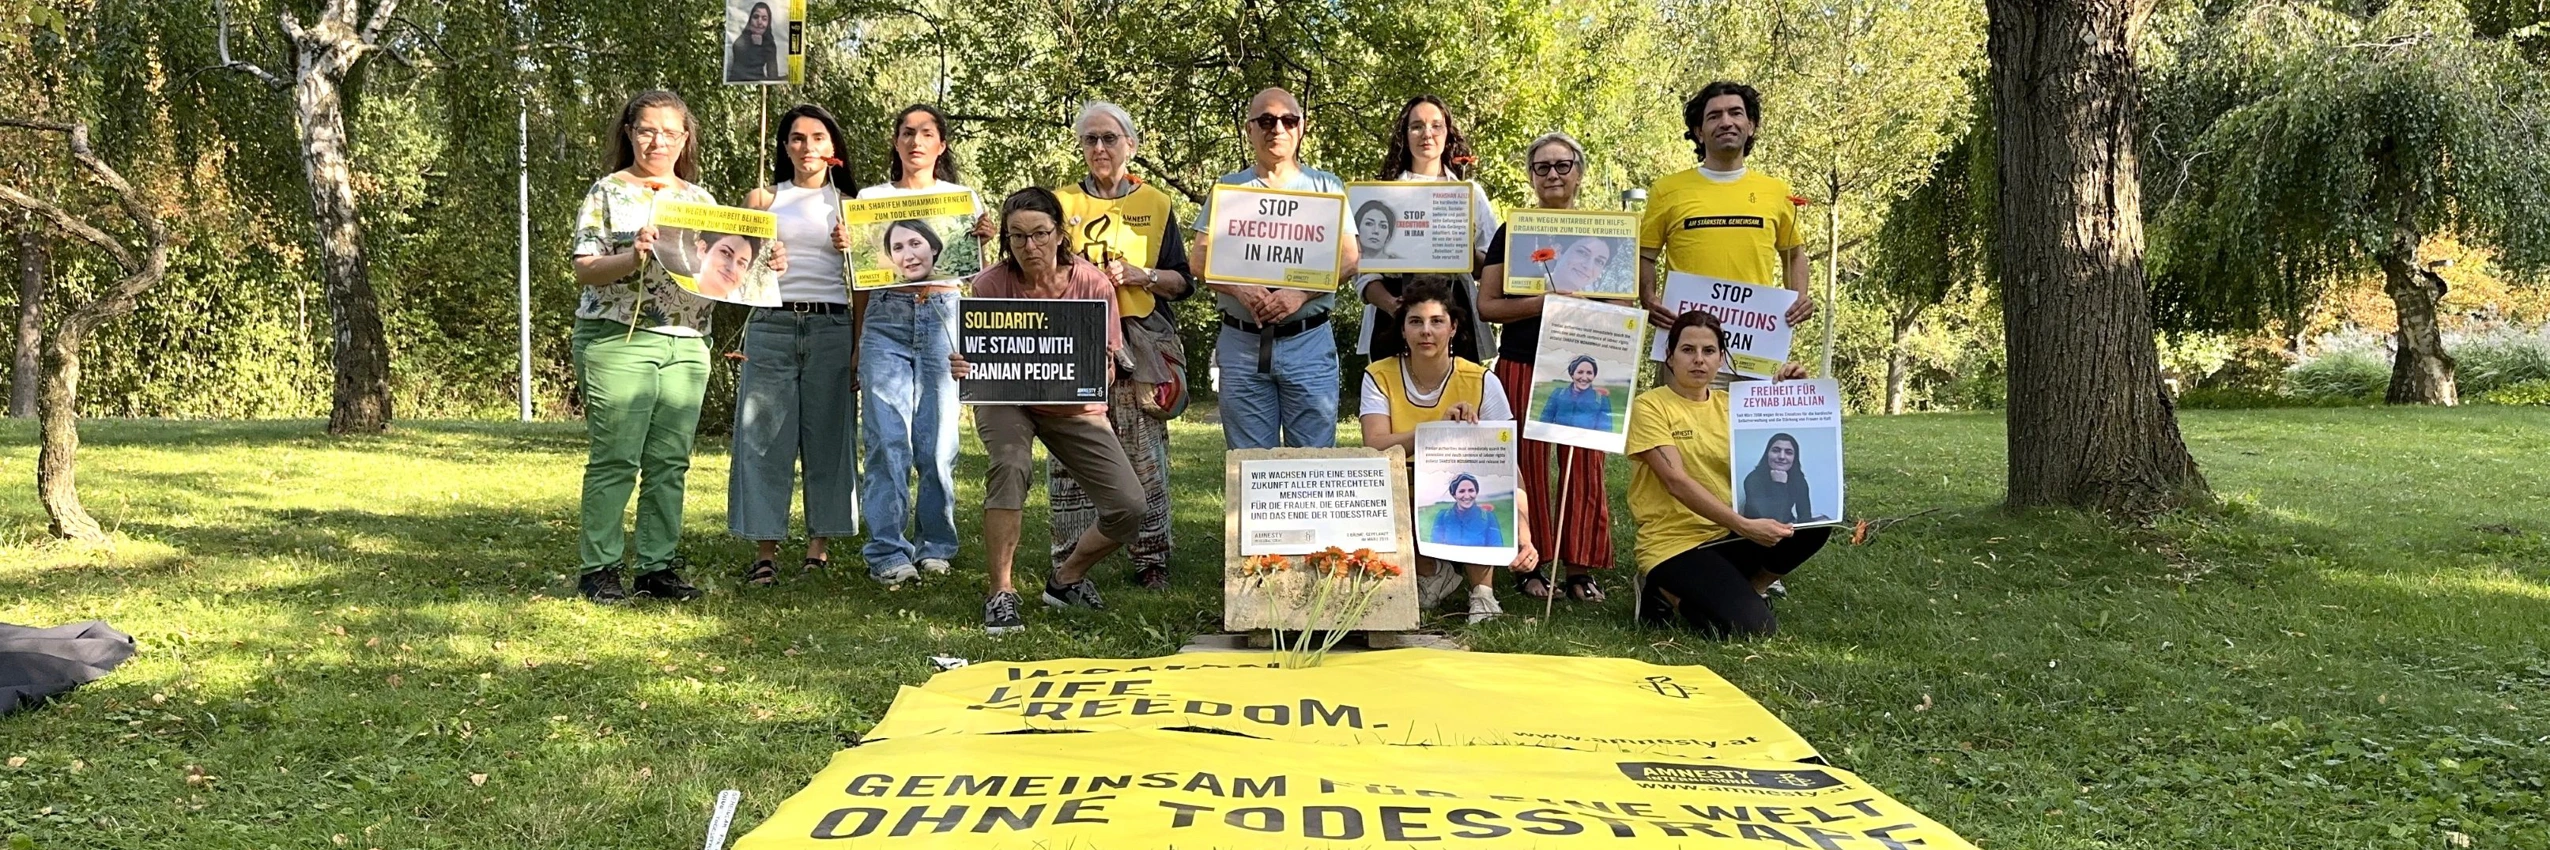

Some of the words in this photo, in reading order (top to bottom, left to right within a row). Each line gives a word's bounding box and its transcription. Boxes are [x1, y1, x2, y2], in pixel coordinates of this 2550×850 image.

[868, 200, 901, 210] SHARIFEH
[902, 197, 942, 208] MOHAMMADI
[943, 195, 969, 205] ERNEUT
[1258, 198, 1299, 217] STOP
[685, 207, 707, 217] WEGEN
[708, 210, 741, 221] MITARBEIT
[741, 213, 752, 222] BEI
[874, 212, 889, 220] ZUM
[891, 210, 907, 219] TODE
[909, 207, 946, 217] VERURTEILT
[1122, 214, 1151, 223] AMNESTY
[1404, 211, 1426, 220] STOP
[659, 214, 705, 227] ORGANISATION
[706, 219, 720, 229] ZUM
[721, 221, 737, 232] TODE
[1228, 219, 1325, 242] EXECUTIONS
[1593, 227, 1631, 235] VERURTEILT!
[1245, 243, 1261, 261] IN
[1267, 245, 1304, 264] IRAN
[1711, 283, 1753, 304] STOP
[965, 311, 1049, 330] SOLIDARITY:
[965, 336, 986, 354] WE
[990, 336, 1035, 354] STAND
[1038, 336, 1074, 354] WITH
[1025, 363, 1075, 381] PEOPLE
[1751, 385, 1794, 396] FREIHEIT
[1797, 383, 1815, 395] FÜR
[1743, 397, 1779, 408] ZEYNAB
[1782, 395, 1825, 407] JALALIAN
[1251, 472, 1266, 480] WIR
[1269, 471, 1307, 479] WACHSEN
[1309, 469, 1324, 478] FÜR
[1327, 470, 1344, 478] EINE
[1347, 469, 1384, 478] BESSERE
[1251, 481, 1288, 490] ZUKUNFT
[1291, 480, 1317, 489] ALLER
[1320, 479, 1385, 488] ENTRECHTETEN
[1280, 490, 1323, 499] MENSCHEN
[1325, 490, 1334, 498] IM
[1251, 500, 1267, 510] FÜR
[1269, 502, 1281, 510] DIE
[1320, 501, 1333, 509] DIE
[1334, 499, 1387, 508] GEFANGENEN
[1251, 512, 1267, 520] UND
[1269, 511, 1286, 520] DAS
[1288, 511, 1309, 519] ENDE
[1311, 511, 1327, 519] DER
[1330, 509, 1388, 518] TODESSTRAFE
[1513, 732, 1761, 748] www.amnesty.at
[1643, 767, 1749, 780] AMNESTY
[1647, 775, 1759, 786] INTERNATIONAL
[1636, 781, 1857, 798] www.amnesty.at
[845, 771, 1286, 798] GEMEINSAM
[1680, 798, 1884, 825] WELT
[810, 795, 1116, 840] OHNE
